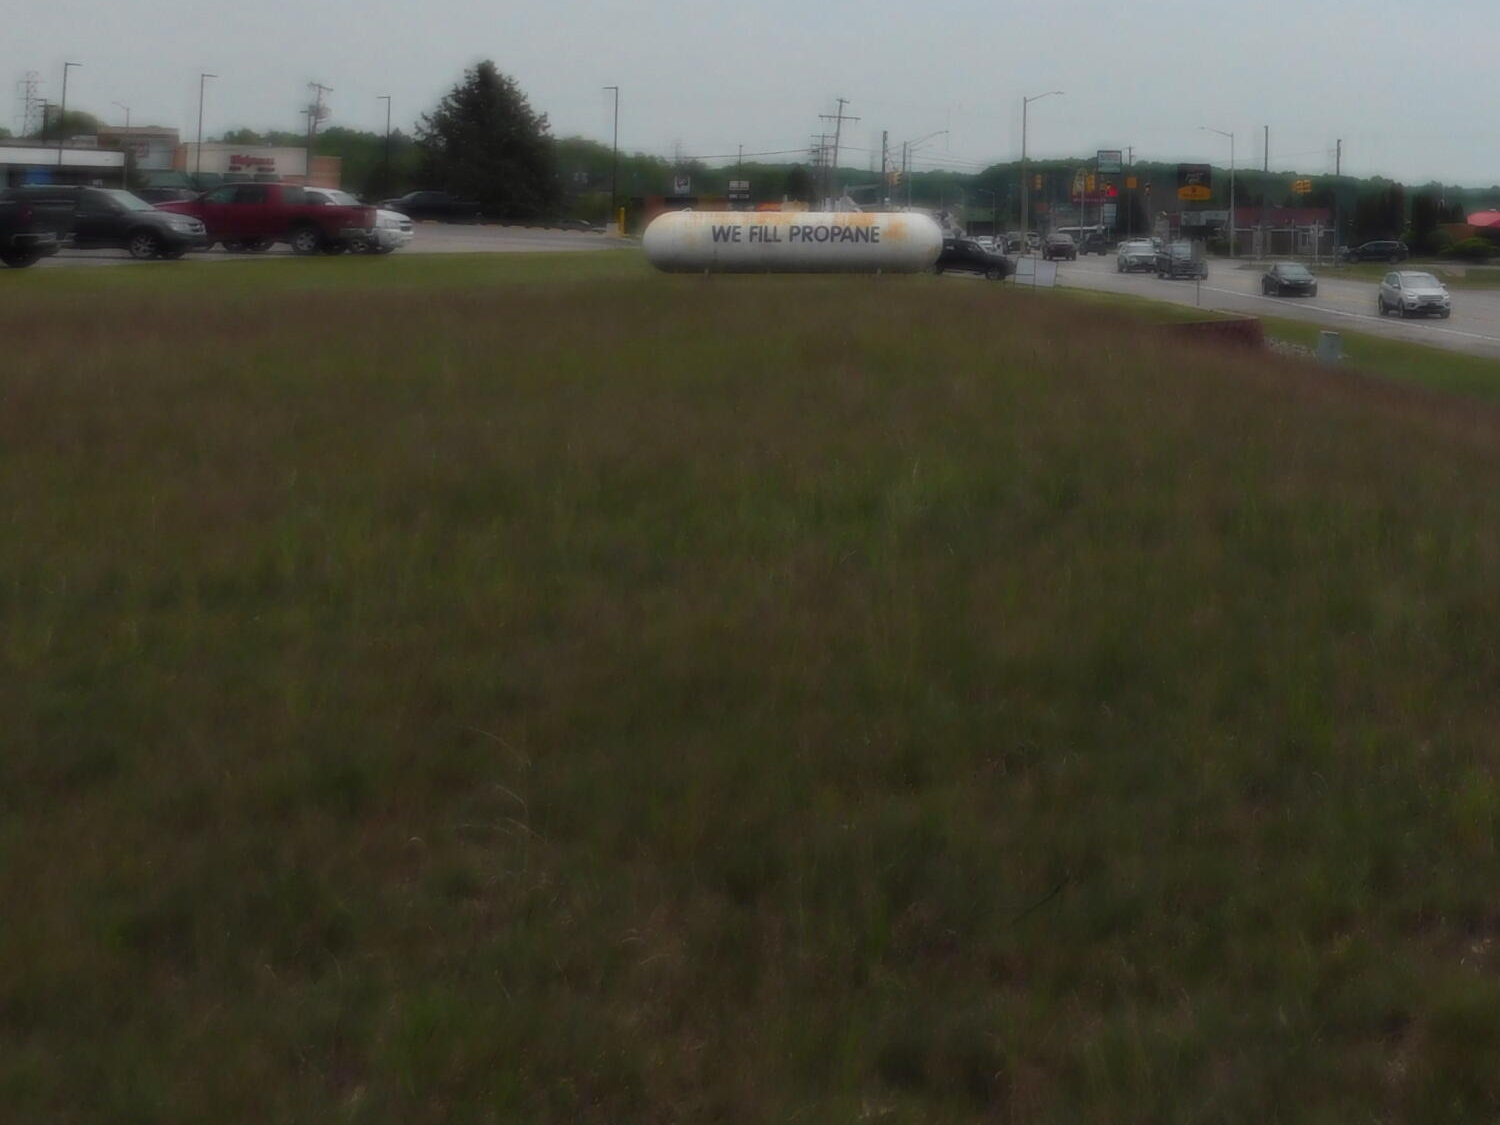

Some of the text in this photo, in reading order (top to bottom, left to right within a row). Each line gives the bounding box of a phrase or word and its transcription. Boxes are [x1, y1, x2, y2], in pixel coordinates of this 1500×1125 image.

[712, 225, 880, 243] WE FILL PROPANE
